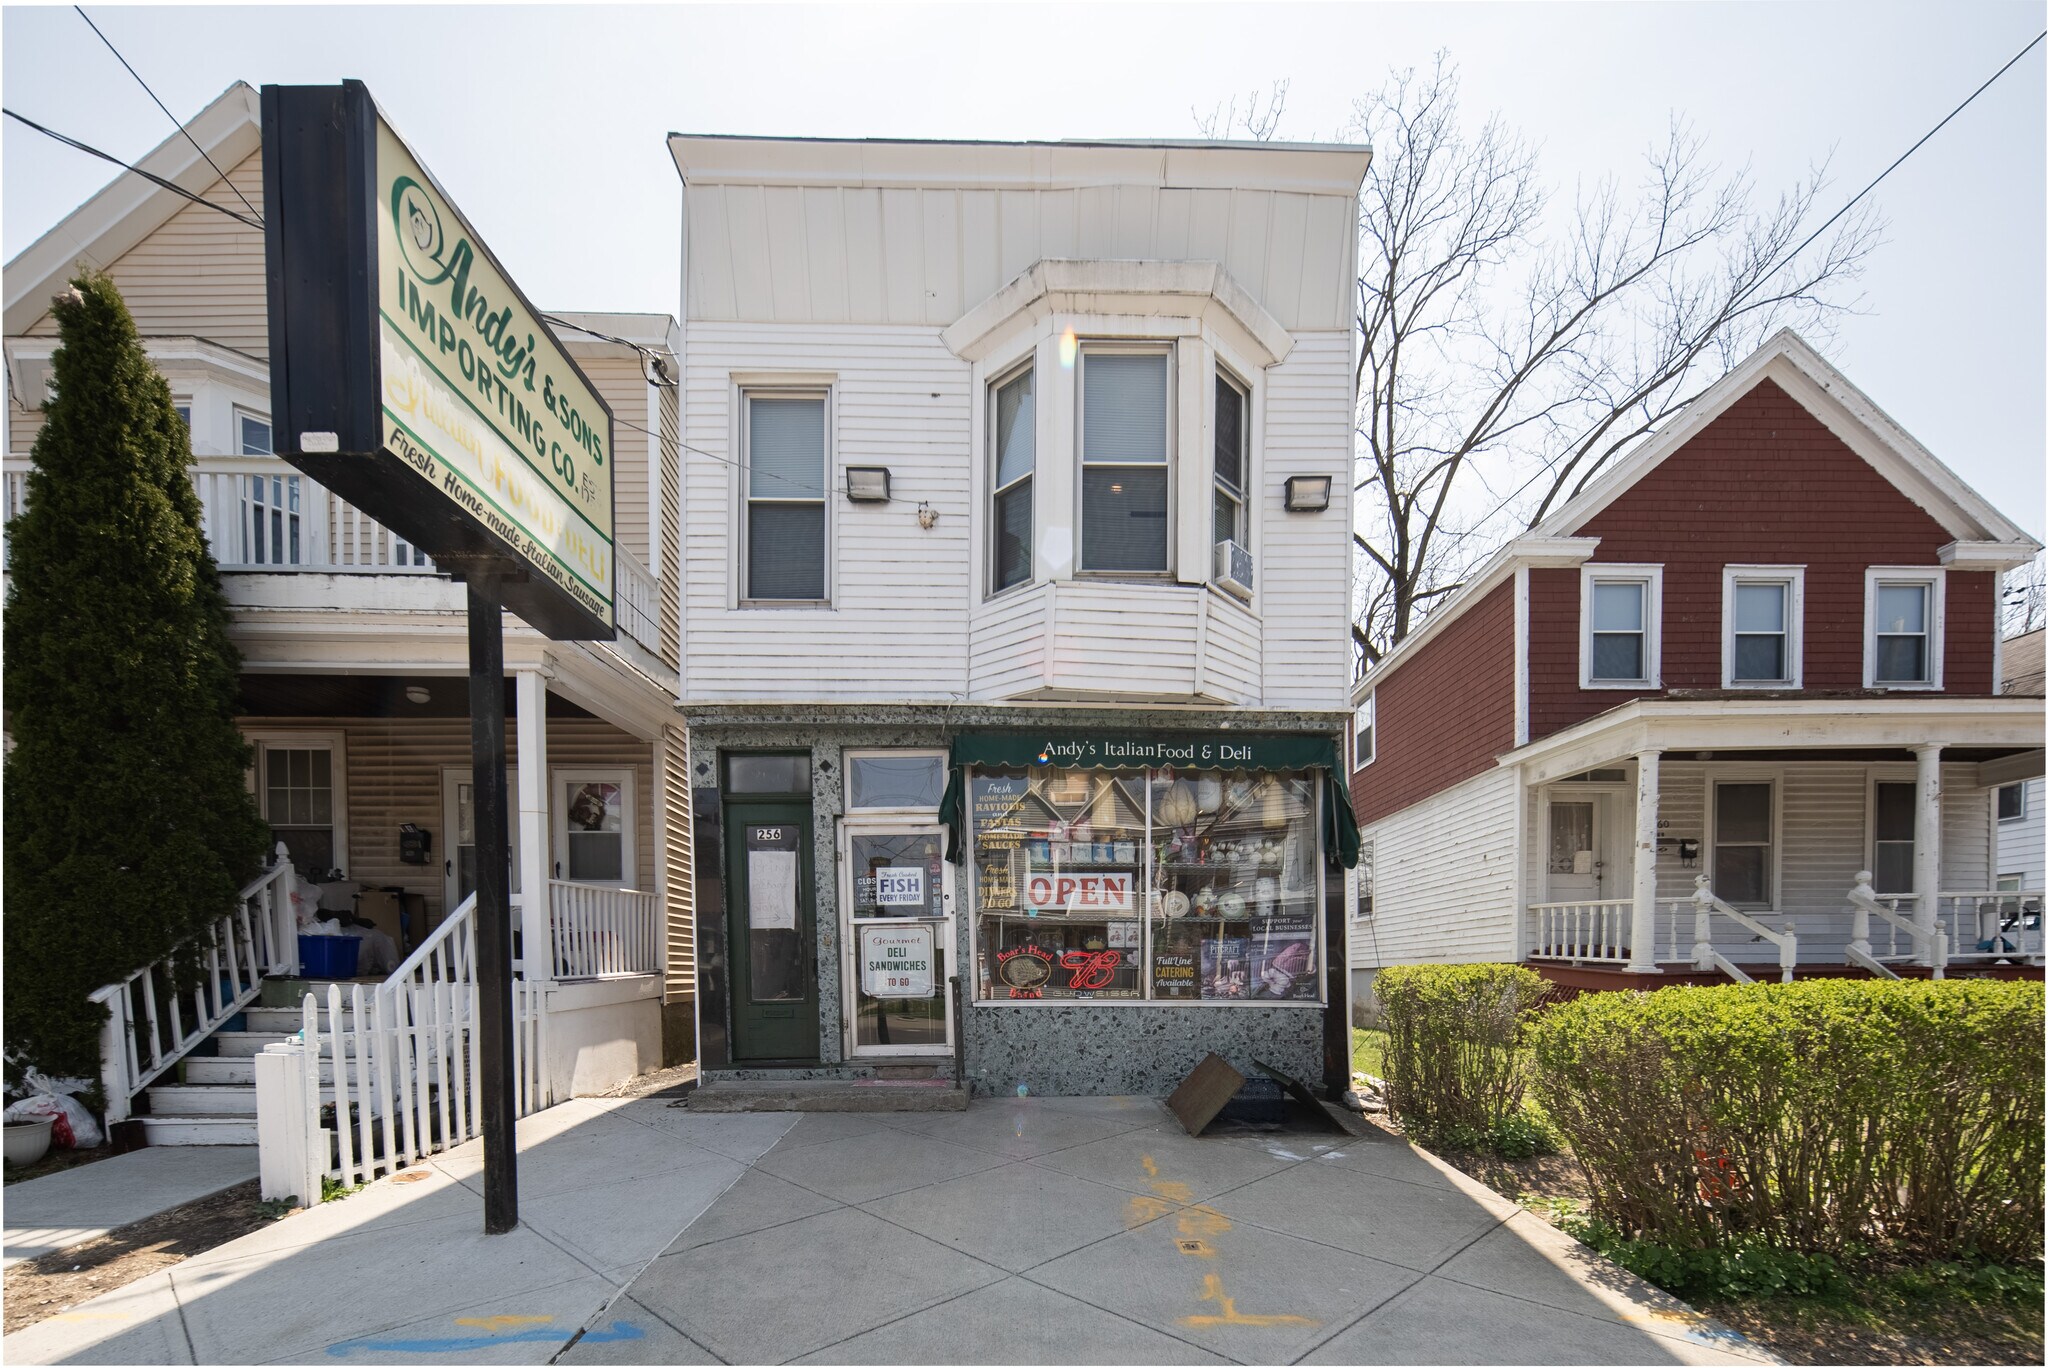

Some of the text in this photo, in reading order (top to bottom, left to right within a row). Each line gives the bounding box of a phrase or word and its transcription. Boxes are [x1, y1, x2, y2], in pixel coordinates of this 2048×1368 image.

[398, 266, 579, 494] IMPORTING CO.
[559, 394, 603, 466] SONS
[390, 428, 436, 478] Fresh
[444, 472, 520, 548] Home-made
[522, 540, 564, 585] Italian
[564, 576, 604, 617] Sausage
[1043, 740, 1252, 760] Andy's Italian Food & Deli
[988, 782, 1012, 794] Fresh
[979, 794, 1021, 802] HOME-MADE
[976, 802, 1025, 812] RAVIOLIS
[980, 817, 1021, 827] PASTAS
[758, 830, 780, 839] 256
[982, 841, 1020, 849] SAUCES
[985, 864, 1009, 874] Fresh
[858, 878, 876, 886] CLOS
[880, 878, 920, 893] FISH
[1028, 877, 1126, 906] OPEN
[880, 894, 898, 902] EVERY
[899, 894, 920, 902] FRIDAY
[872, 937, 922, 946] Gourmet
[888, 947, 906, 958] DELI
[996, 944, 1054, 962] Boar's Head
[869, 960, 927, 971] SANDWICHES
[1156, 956, 1193, 966] Full Line
[1155, 966, 1194, 978] CATERING
[888, 978, 910, 986] TO GO
[1156, 979, 1194, 987] Available
